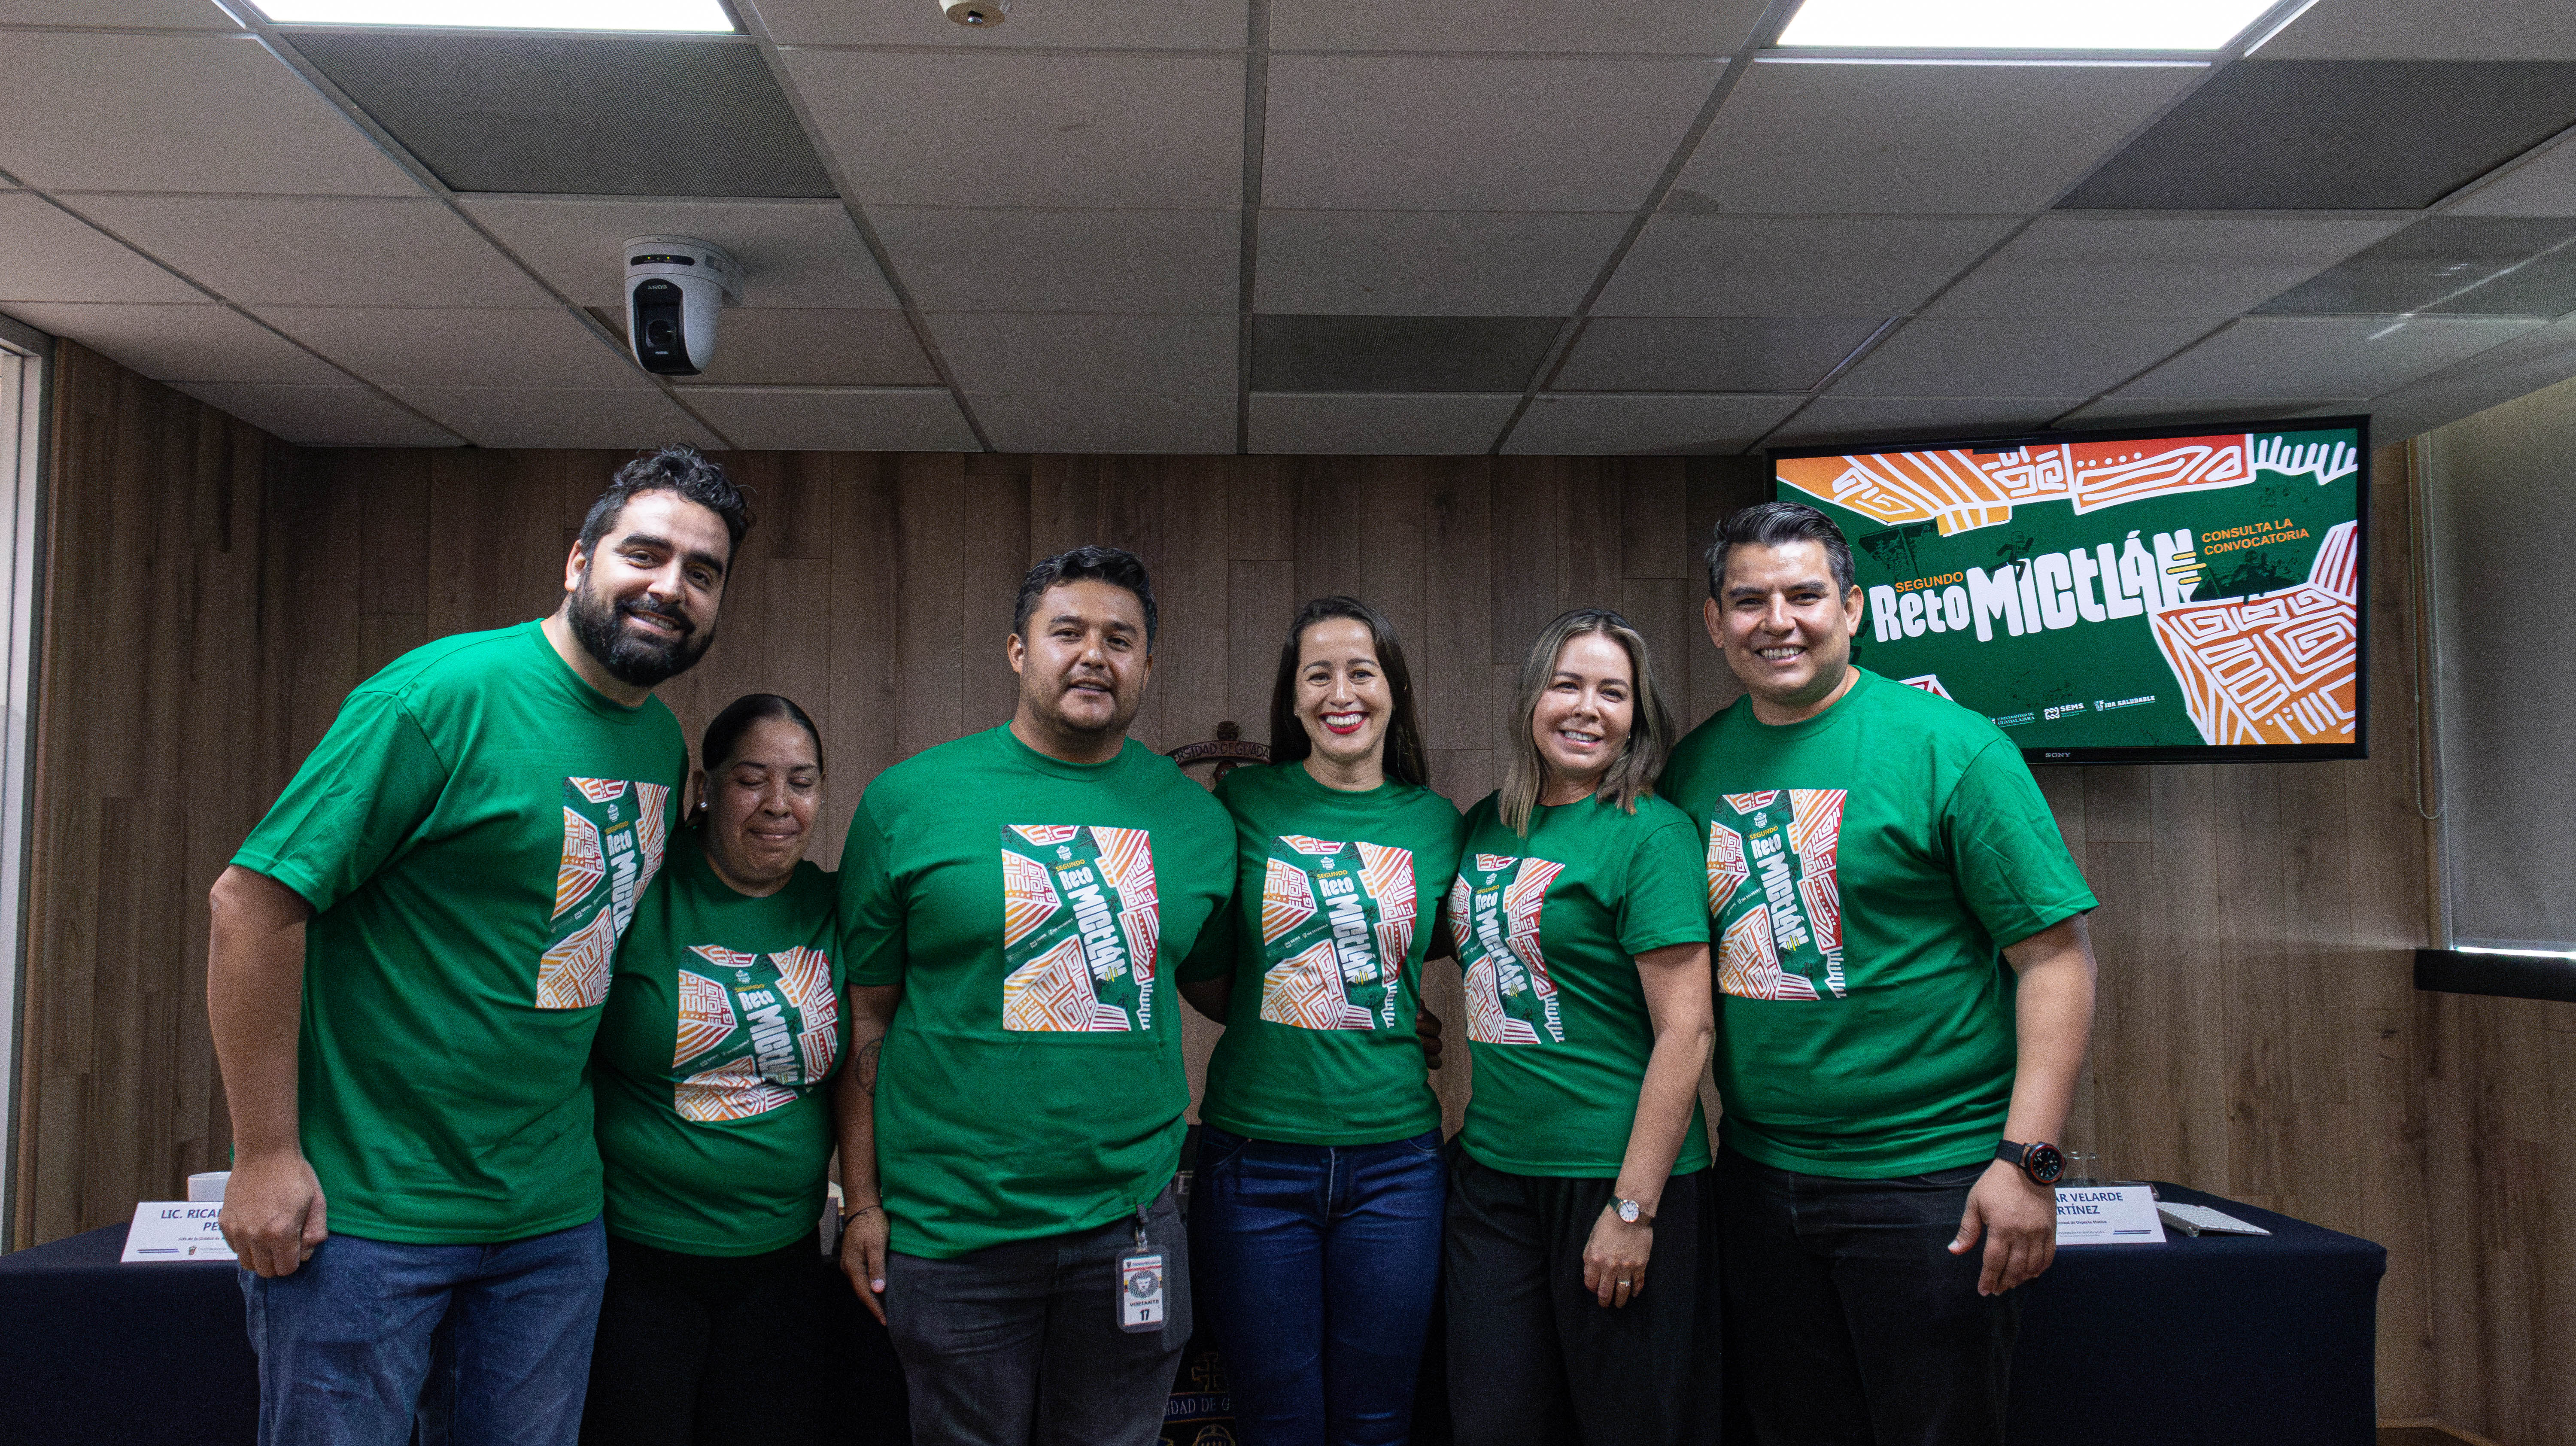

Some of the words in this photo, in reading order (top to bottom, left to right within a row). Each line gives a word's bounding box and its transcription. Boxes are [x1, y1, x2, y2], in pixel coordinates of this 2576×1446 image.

[2202, 522, 2272, 542] CONSULTA
[2274, 518, 2293, 530] LA
[2204, 528, 2310, 555] CONVOCATORIA
[1895, 571, 1964, 592] SEGUNDO
[1868, 584, 1970, 643] Reto
[2060, 703, 2084, 712] SEMS
[2117, 695, 2155, 706] SALUDABLE
[1997, 713, 2027, 721] UNIVERSIDAD
[1998, 716, 2035, 725] GUADALAJARA
[1749, 826, 1779, 841] SEGUNDO
[1750, 833, 1782, 859] Reto
[1055, 859, 1085, 872] SEGUNDO
[1058, 866, 1094, 891] Reto
[1317, 869, 1348, 879] SEGUNDO
[1319, 877, 1355, 897] Reto
[1475, 892, 1498, 913] Reto
[738, 990, 775, 1011] Reto
[2070, 1192, 2123, 1202] VELARDE
[161, 1209, 182, 1219] LIC.
[2057, 1203, 2100, 1215] RTÍNEZ
[1139, 1308, 1150, 1321] 17
[1201, 1397, 1216, 1413] DE
